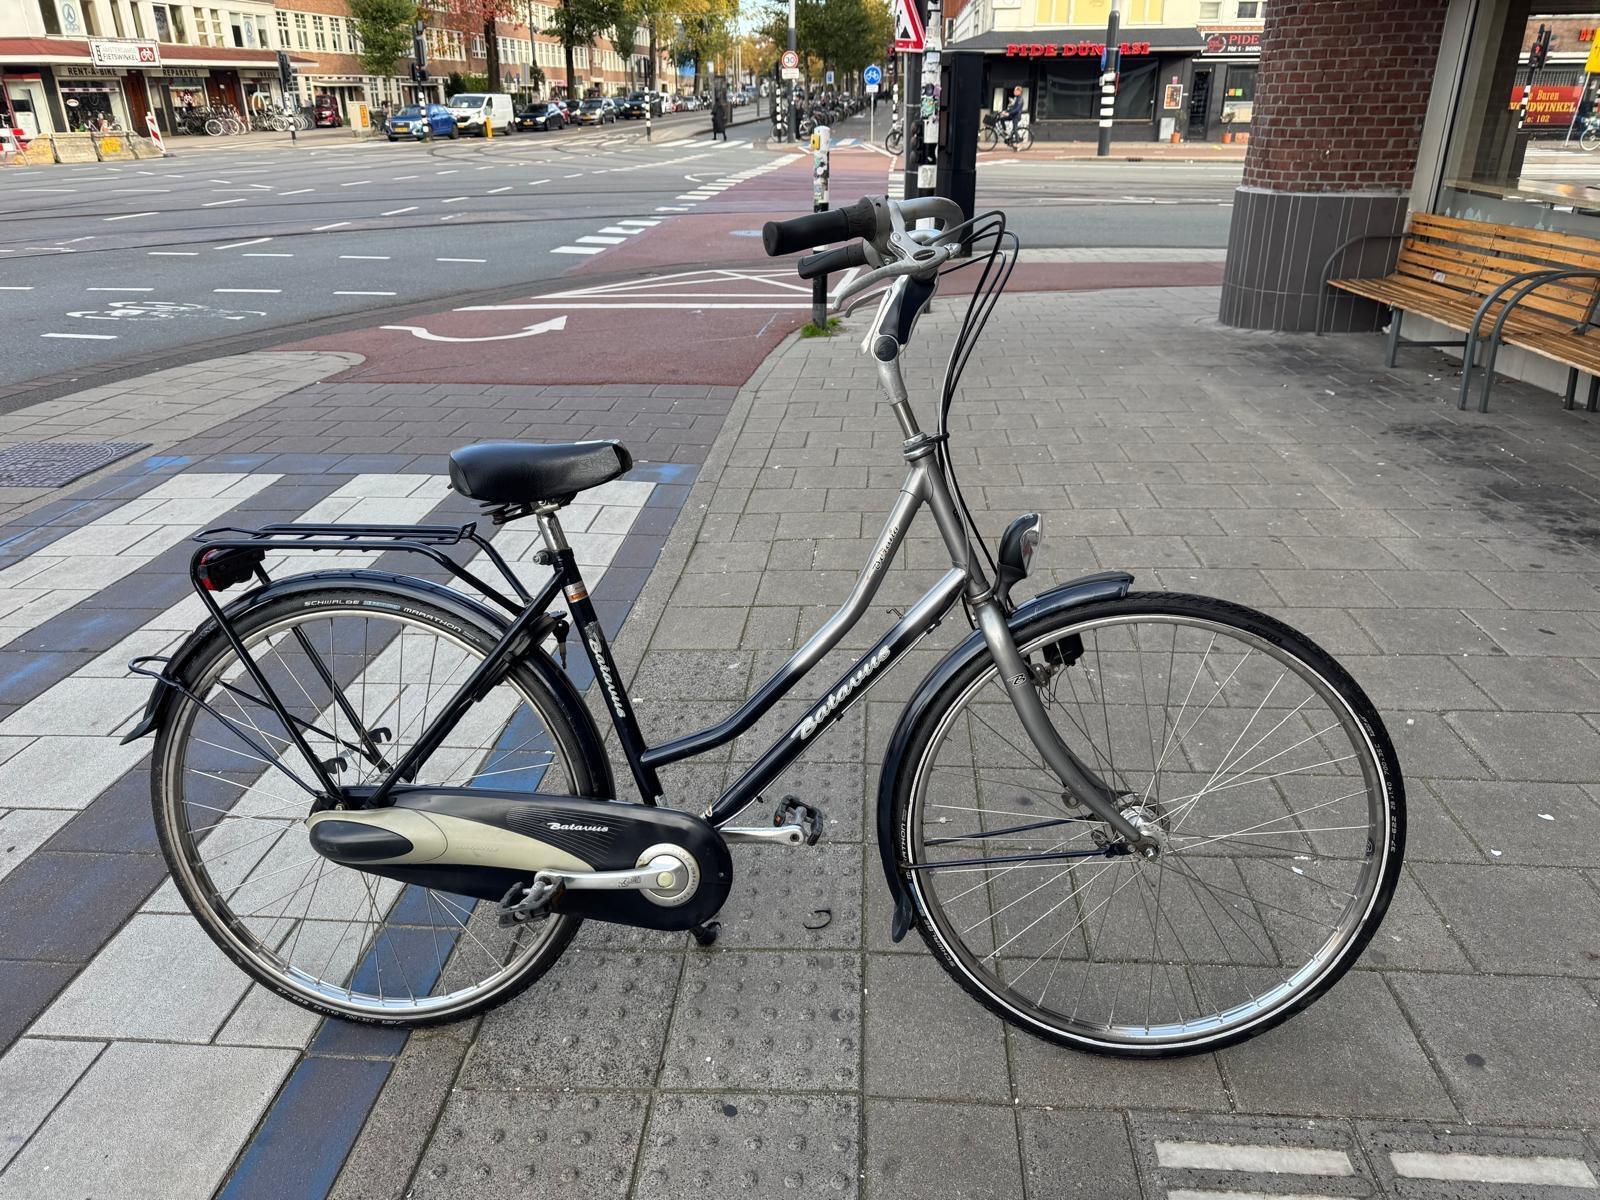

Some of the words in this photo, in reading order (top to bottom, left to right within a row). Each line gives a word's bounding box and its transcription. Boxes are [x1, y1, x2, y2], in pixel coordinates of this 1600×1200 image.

[1228, 34, 1260, 45] PIDE
[1006, 43, 1058, 57] PIDE
[1062, 40, 1151, 57] DÜNASI
[67, 67, 118, 76] RENT-A-BIKE
[162, 69, 199, 77] REPARATIE
[403, 607, 462, 633] MARATHON
[588, 632, 627, 719] Batavus
[791, 645, 891, 740] Batavus
[546, 822, 609, 832] Batavus
